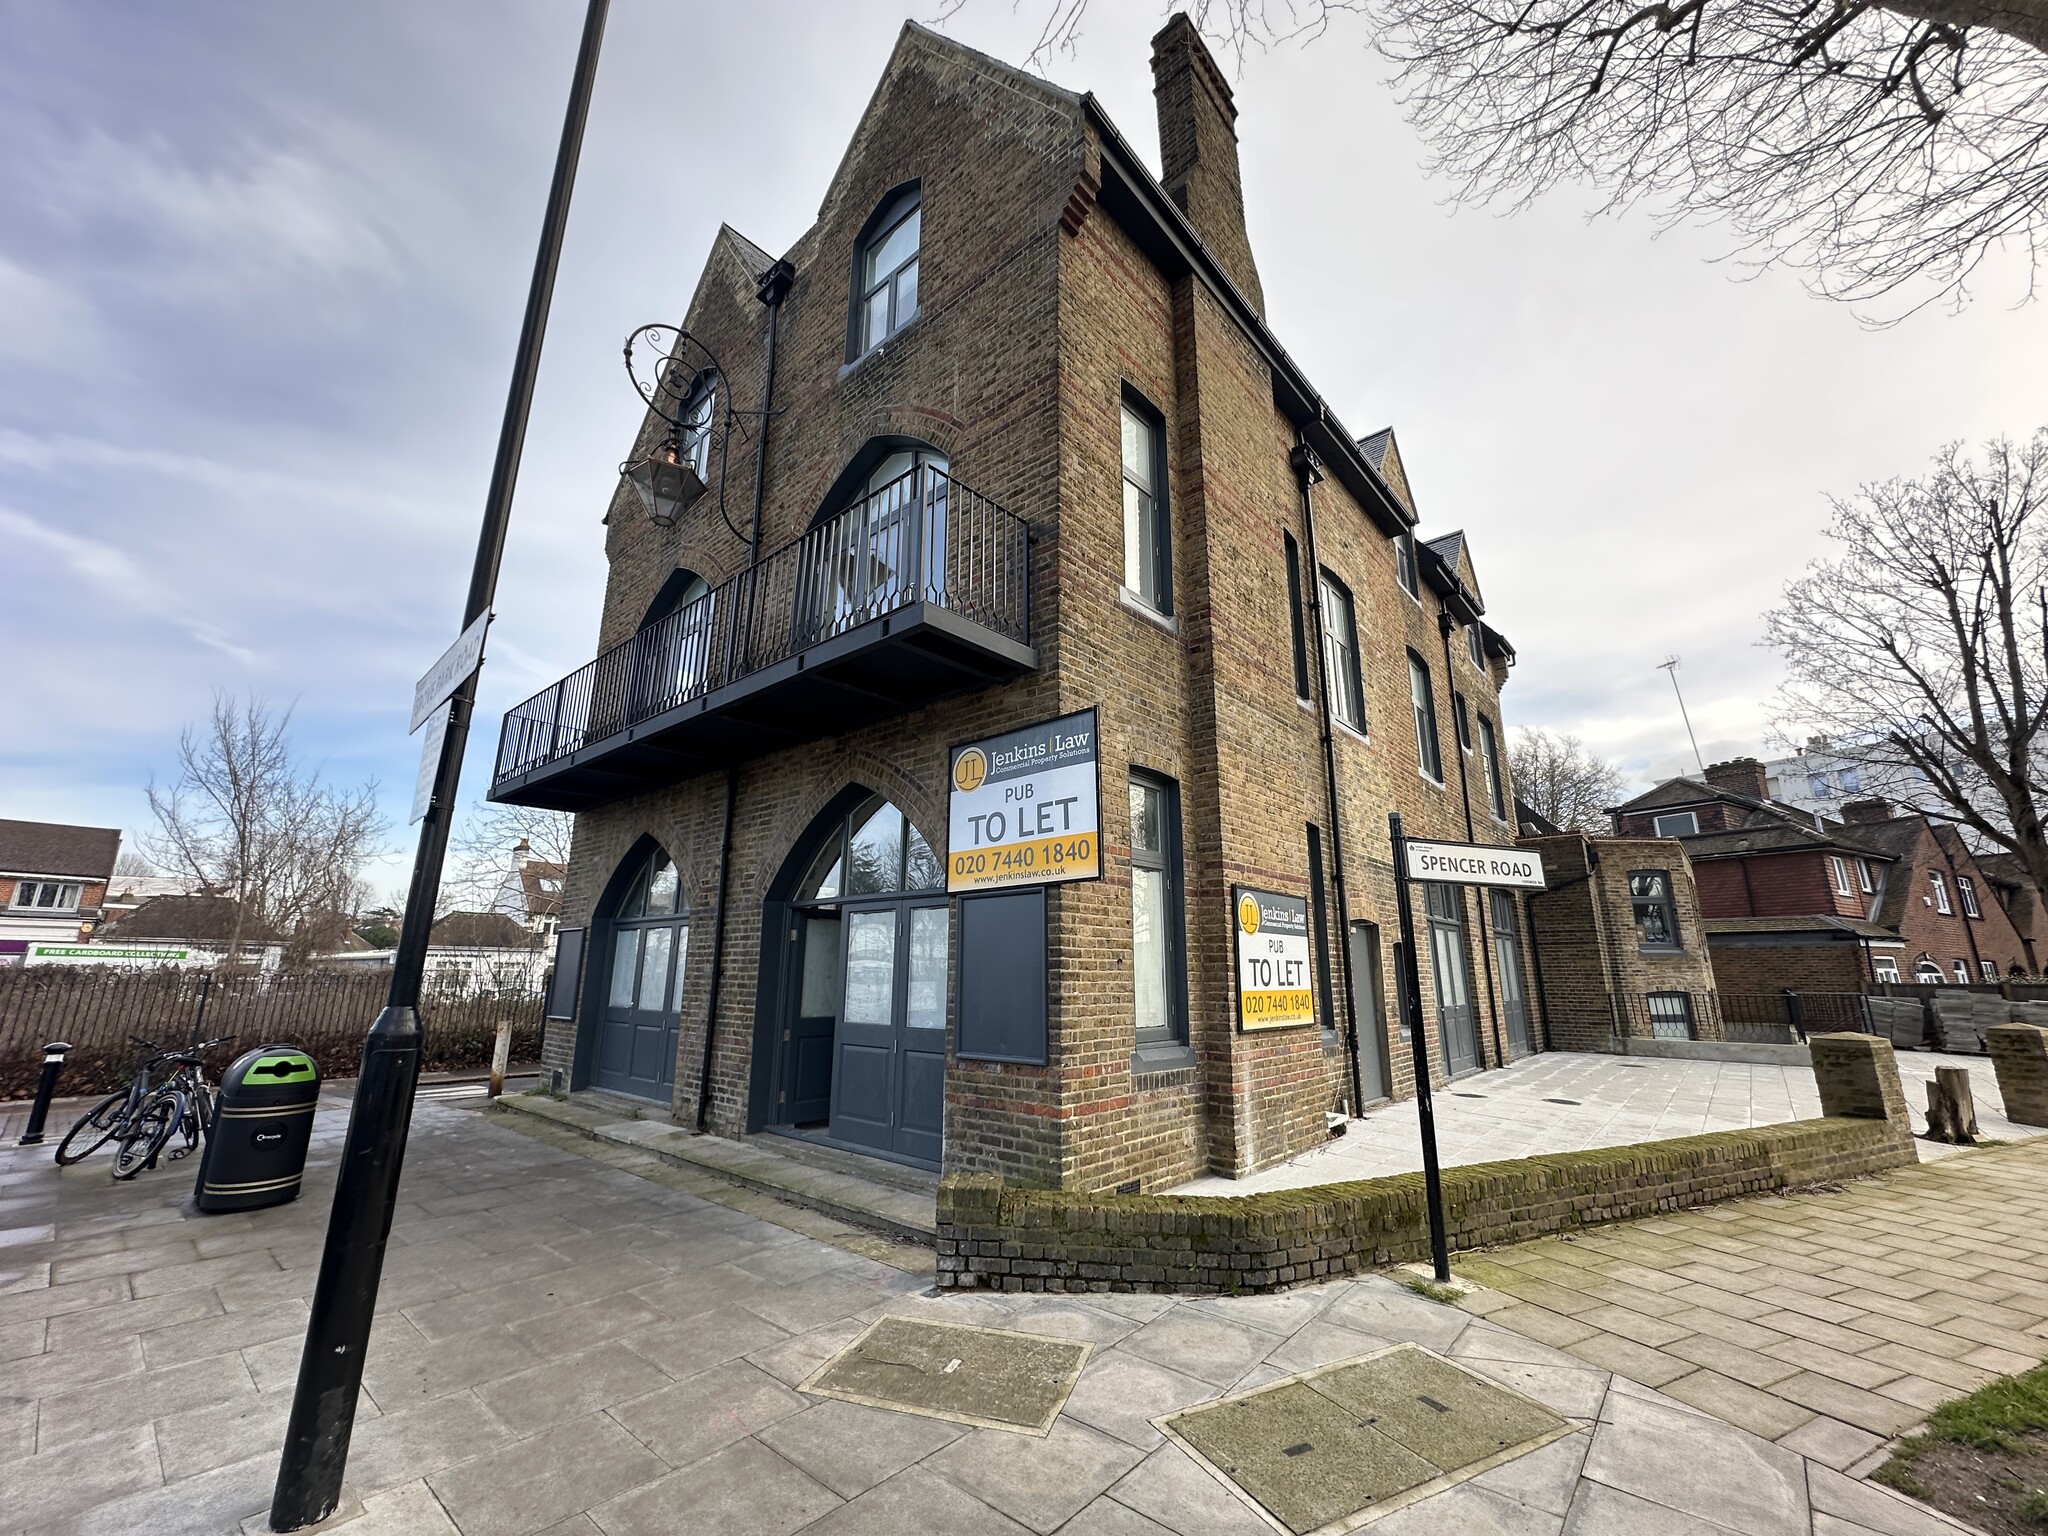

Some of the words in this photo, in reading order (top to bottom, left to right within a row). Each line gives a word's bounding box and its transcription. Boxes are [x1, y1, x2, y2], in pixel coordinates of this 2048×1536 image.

[991, 742, 1046, 775] Jenkins
[1055, 732, 1090, 752] Law
[996, 760, 1030, 774] Commercial
[1031, 754, 1058, 766] Property
[1059, 747, 1090, 759] Solutions
[1005, 783, 1034, 803] PUB
[968, 811, 1006, 845] TO
[1018, 796, 1078, 838] LET
[955, 854, 986, 875] 020
[992, 847, 1034, 871] 7440
[1043, 839, 1090, 865] 1840
[1421, 855, 1487, 875] SPENCER
[1491, 861, 1532, 877] ROAD
[974, 865, 1066, 884] www.jenkinslaw.co.uk
[1261, 904, 1289, 926] Jenkins
[1291, 909, 1305, 923] Law
[69, 949, 123, 957] CARDBOARD
[1269, 939, 1284, 954] PUB
[1248, 958, 1272, 987] TO
[1277, 959, 1303, 987] LET
[1245, 996, 1264, 1014] 020
[1267, 995, 1288, 1013] 7440
[1290, 994, 1309, 1011] 1840
